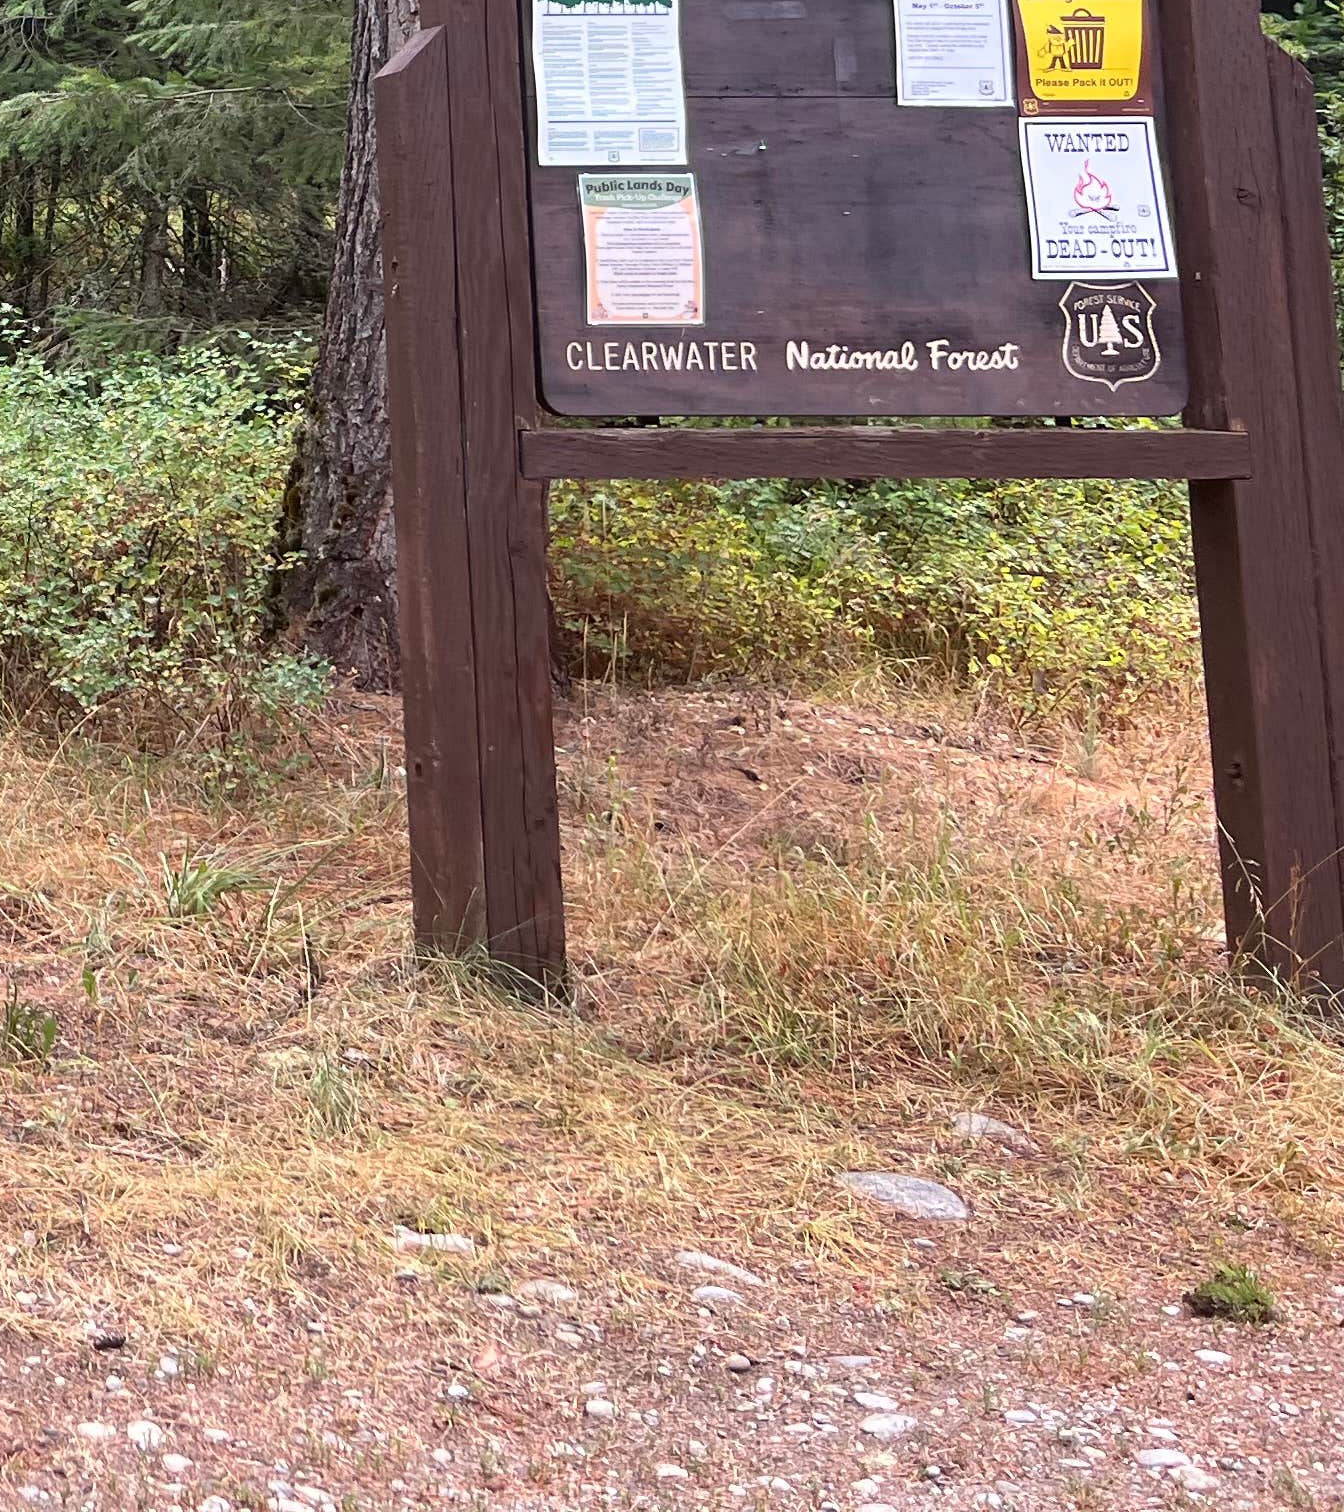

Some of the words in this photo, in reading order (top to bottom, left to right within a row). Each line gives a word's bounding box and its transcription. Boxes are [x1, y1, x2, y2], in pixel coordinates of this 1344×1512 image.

[1035, 78, 1070, 87] Please
[1072, 78, 1097, 87] Pack
[1108, 78, 1133, 87] OUT!
[1044, 132, 1131, 153] WANTED
[585, 180, 625, 195] Public
[627, 180, 663, 192] Lands
[665, 181, 690, 197] Day
[1059, 222, 1085, 235] Your
[1087, 222, 1138, 238] campfire
[1073, 294, 1104, 311] FOREST
[1106, 294, 1141, 313] SERVICE
[566, 341, 758, 372] CLEARWATER
[785, 340, 918, 371] National
[927, 339, 1020, 371] Forest
